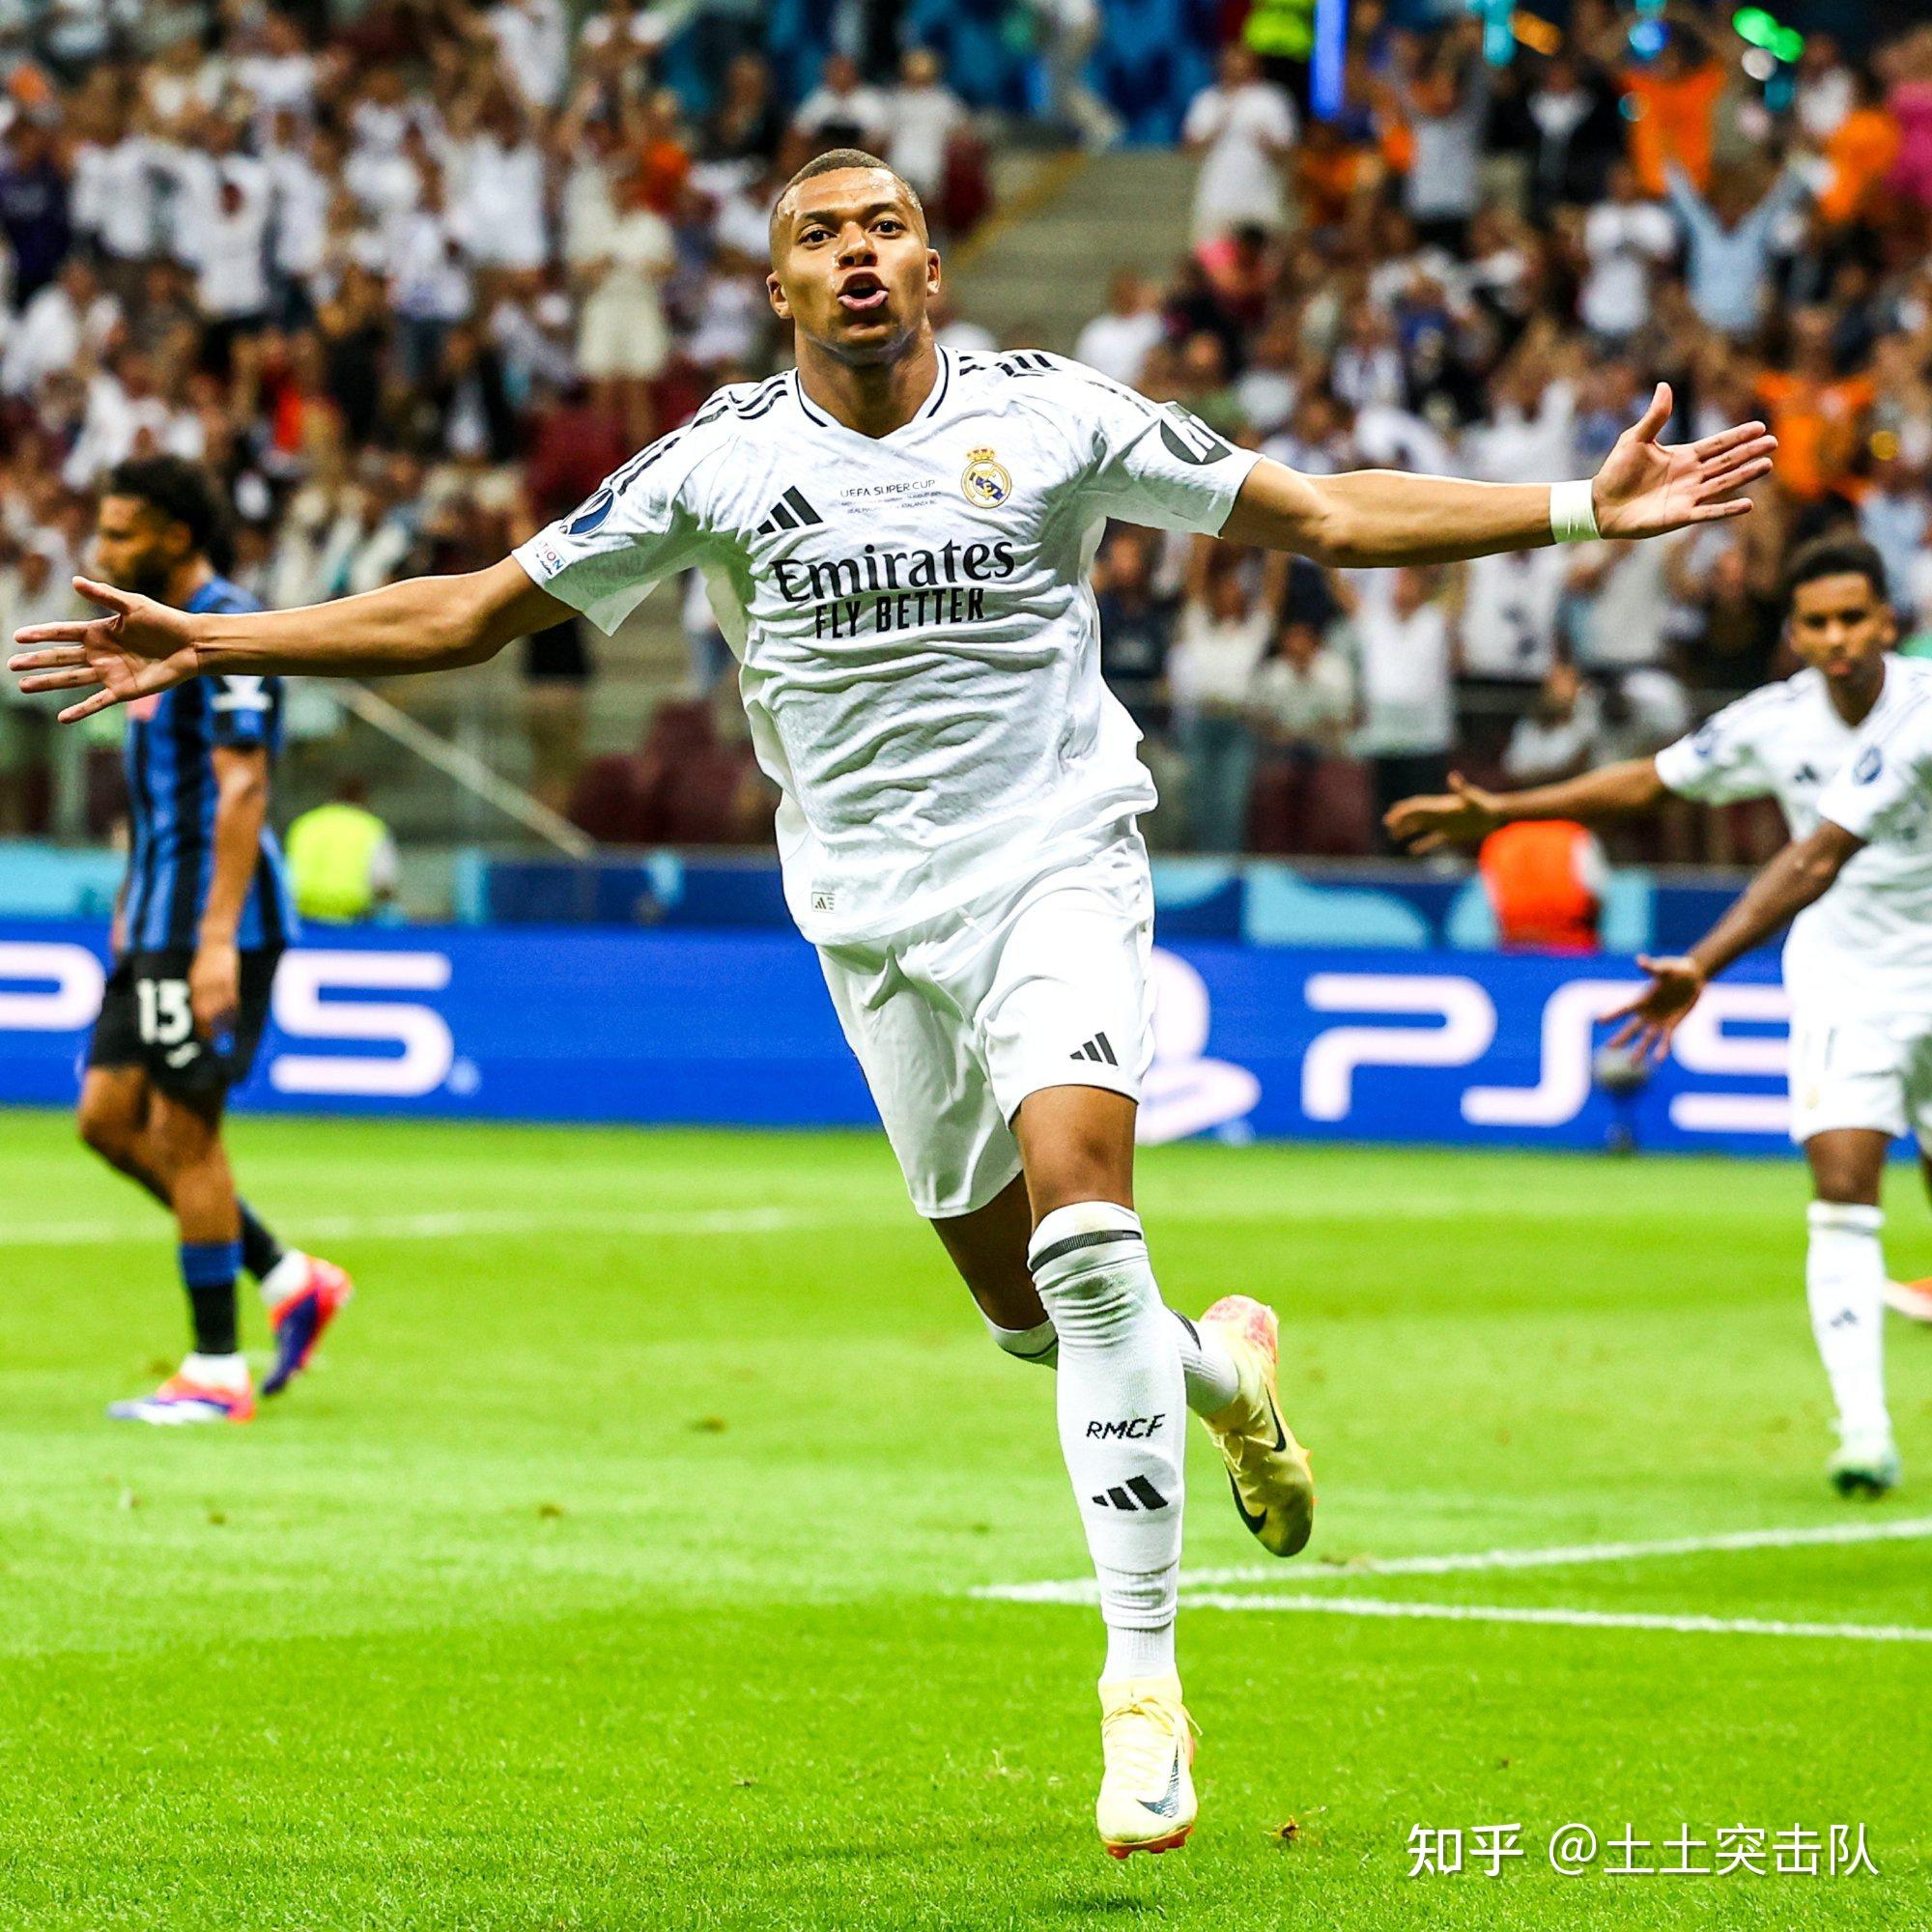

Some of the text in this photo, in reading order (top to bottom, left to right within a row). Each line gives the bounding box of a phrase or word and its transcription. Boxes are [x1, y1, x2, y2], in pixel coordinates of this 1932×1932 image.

[839, 479, 935, 497] UEFA SUPER CUP
[771, 538, 1015, 602] Emirates
[814, 587, 984, 639] FLY BETTER
[1086, 1413, 1166, 1439] RMCF
